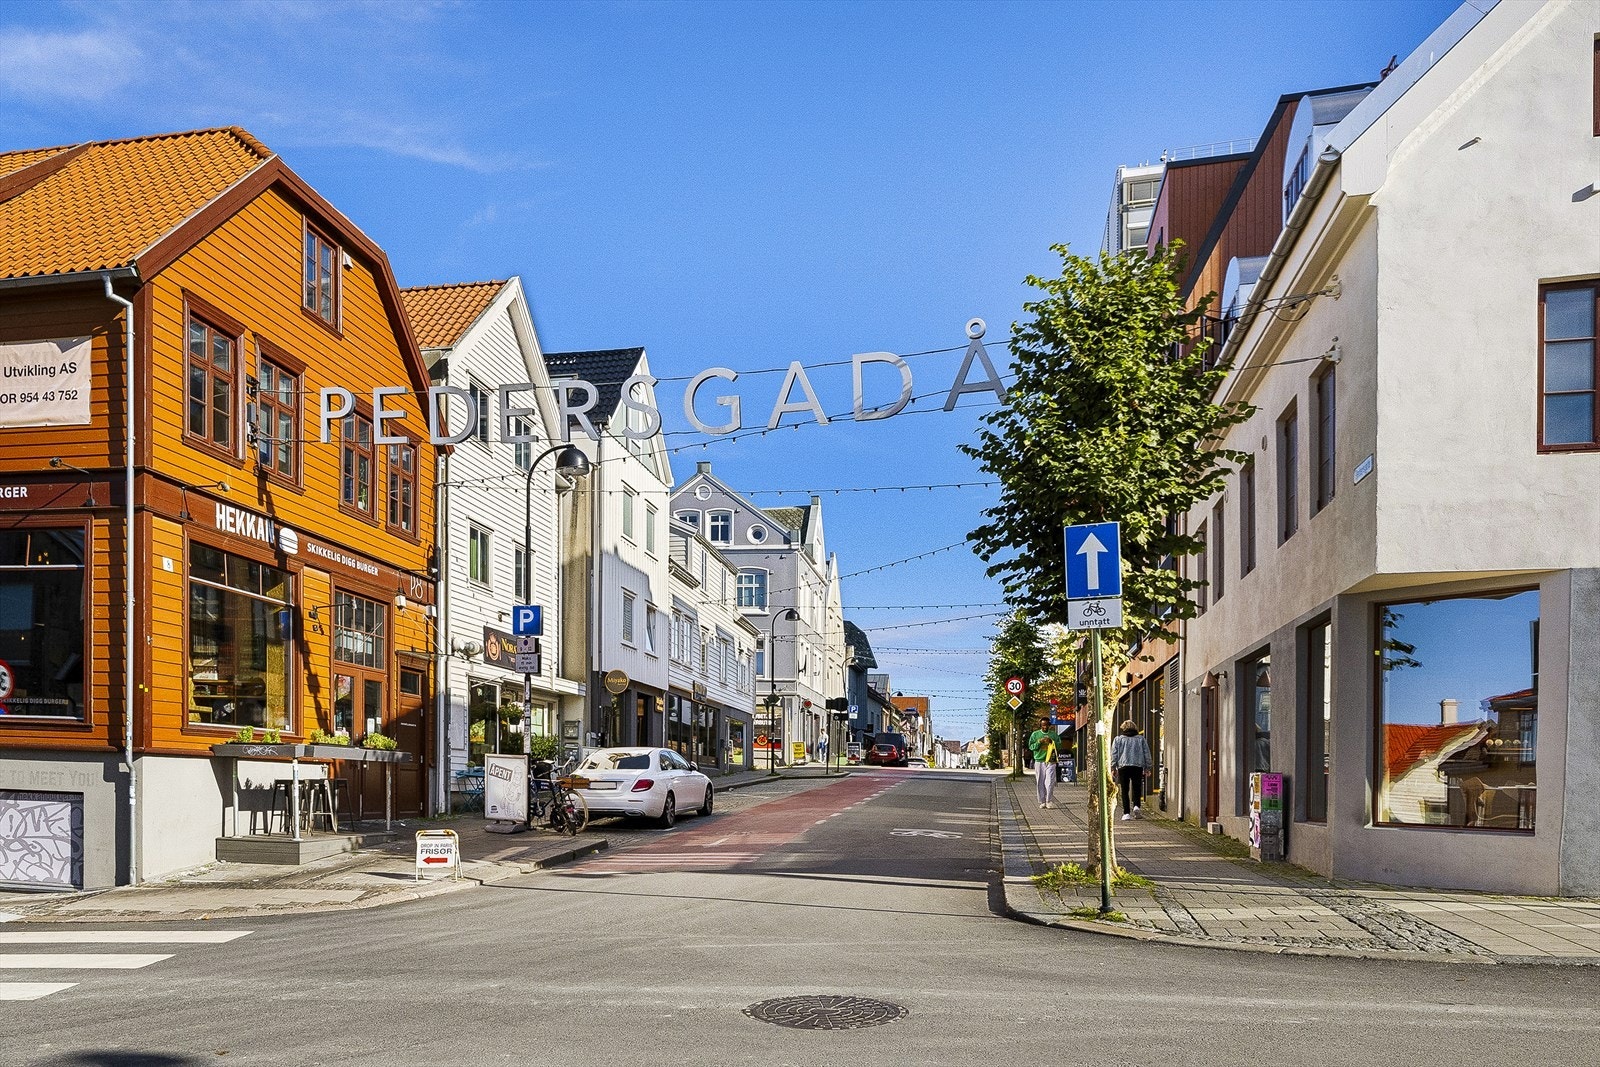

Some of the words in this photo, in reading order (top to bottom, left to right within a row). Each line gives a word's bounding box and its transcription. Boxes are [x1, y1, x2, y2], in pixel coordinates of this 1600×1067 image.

[3, 364, 56, 378] Utvikling
[59, 362, 77, 375] AS
[321, 317, 1010, 446] PEDERSGADÅ
[20, 392, 39, 403] 954
[42, 391, 55, 401] 43
[58, 389, 78, 401] 752
[215, 502, 275, 544] HEKKAN
[307, 542, 341, 563] SKIKKELIG
[341, 555, 356, 569] DIGG
[356, 560, 379, 577] BURGER
[519, 609, 534, 631] P
[1079, 618, 1110, 627] unntatt
[1009, 682, 1021, 690] 30
